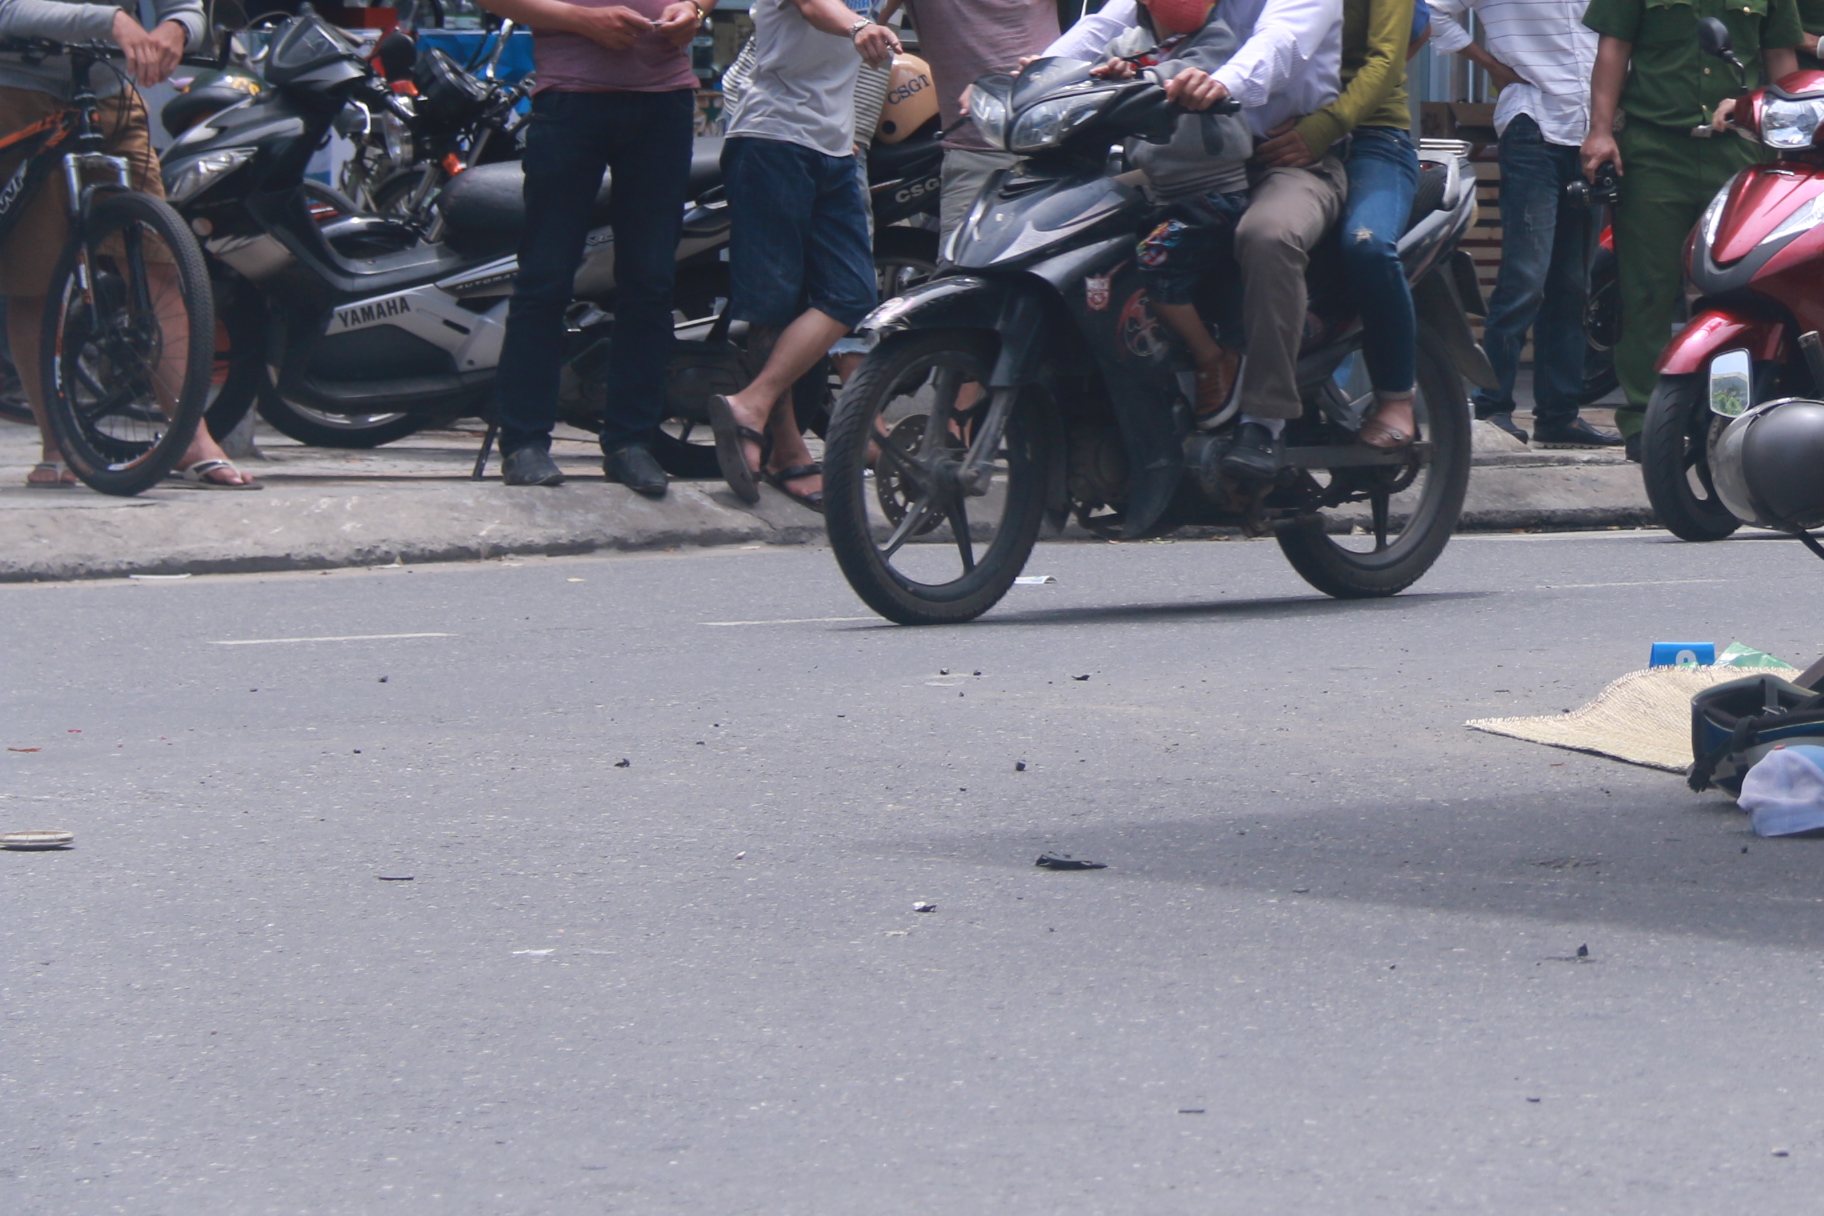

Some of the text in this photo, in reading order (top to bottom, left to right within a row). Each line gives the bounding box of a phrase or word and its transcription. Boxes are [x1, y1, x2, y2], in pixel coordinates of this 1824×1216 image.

[887, 73, 931, 105] CSGT
[894, 177, 941, 204] CSG
[455, 272, 519, 290] AUTOMAT
[338, 296, 411, 328] YAMAHA
